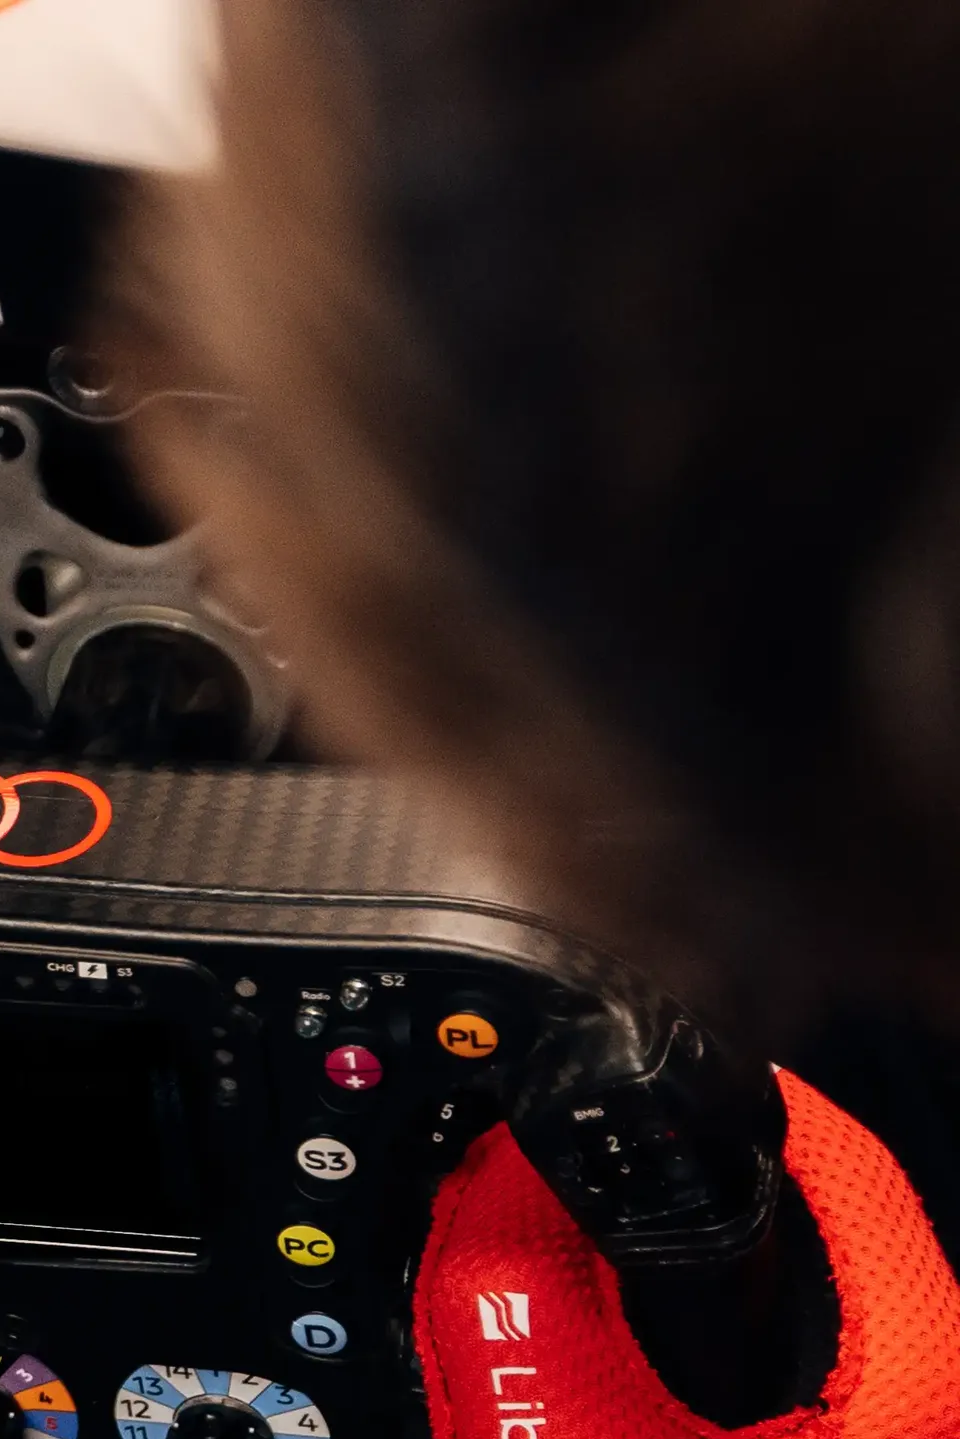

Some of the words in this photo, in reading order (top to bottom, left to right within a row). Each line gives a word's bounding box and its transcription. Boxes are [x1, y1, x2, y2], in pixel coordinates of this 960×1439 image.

[47, 962, 75, 973] CHG
[117, 967, 134, 977] S3
[380, 974, 406, 987] S2
[301, 990, 331, 1001] Radio
[446, 1028, 494, 1049] PL
[344, 1051, 356, 1069] 1
[441, 1103, 454, 1120] 5
[605, 1135, 621, 1153] 2
[304, 1150, 347, 1171] S3
[284, 1237, 330, 1257] PC
[304, 1324, 337, 1348] D
[16, 1368, 34, 1384] 3
[165, 1366, 193, 1380] 14
[131, 1375, 164, 1397] 13
[275, 1385, 295, 1405] 3
[38, 1391, 53, 1405] 4
[120, 1399, 152, 1419] 12
[46, 1416, 58, 1431] 5
[298, 1413, 318, 1432] 4
